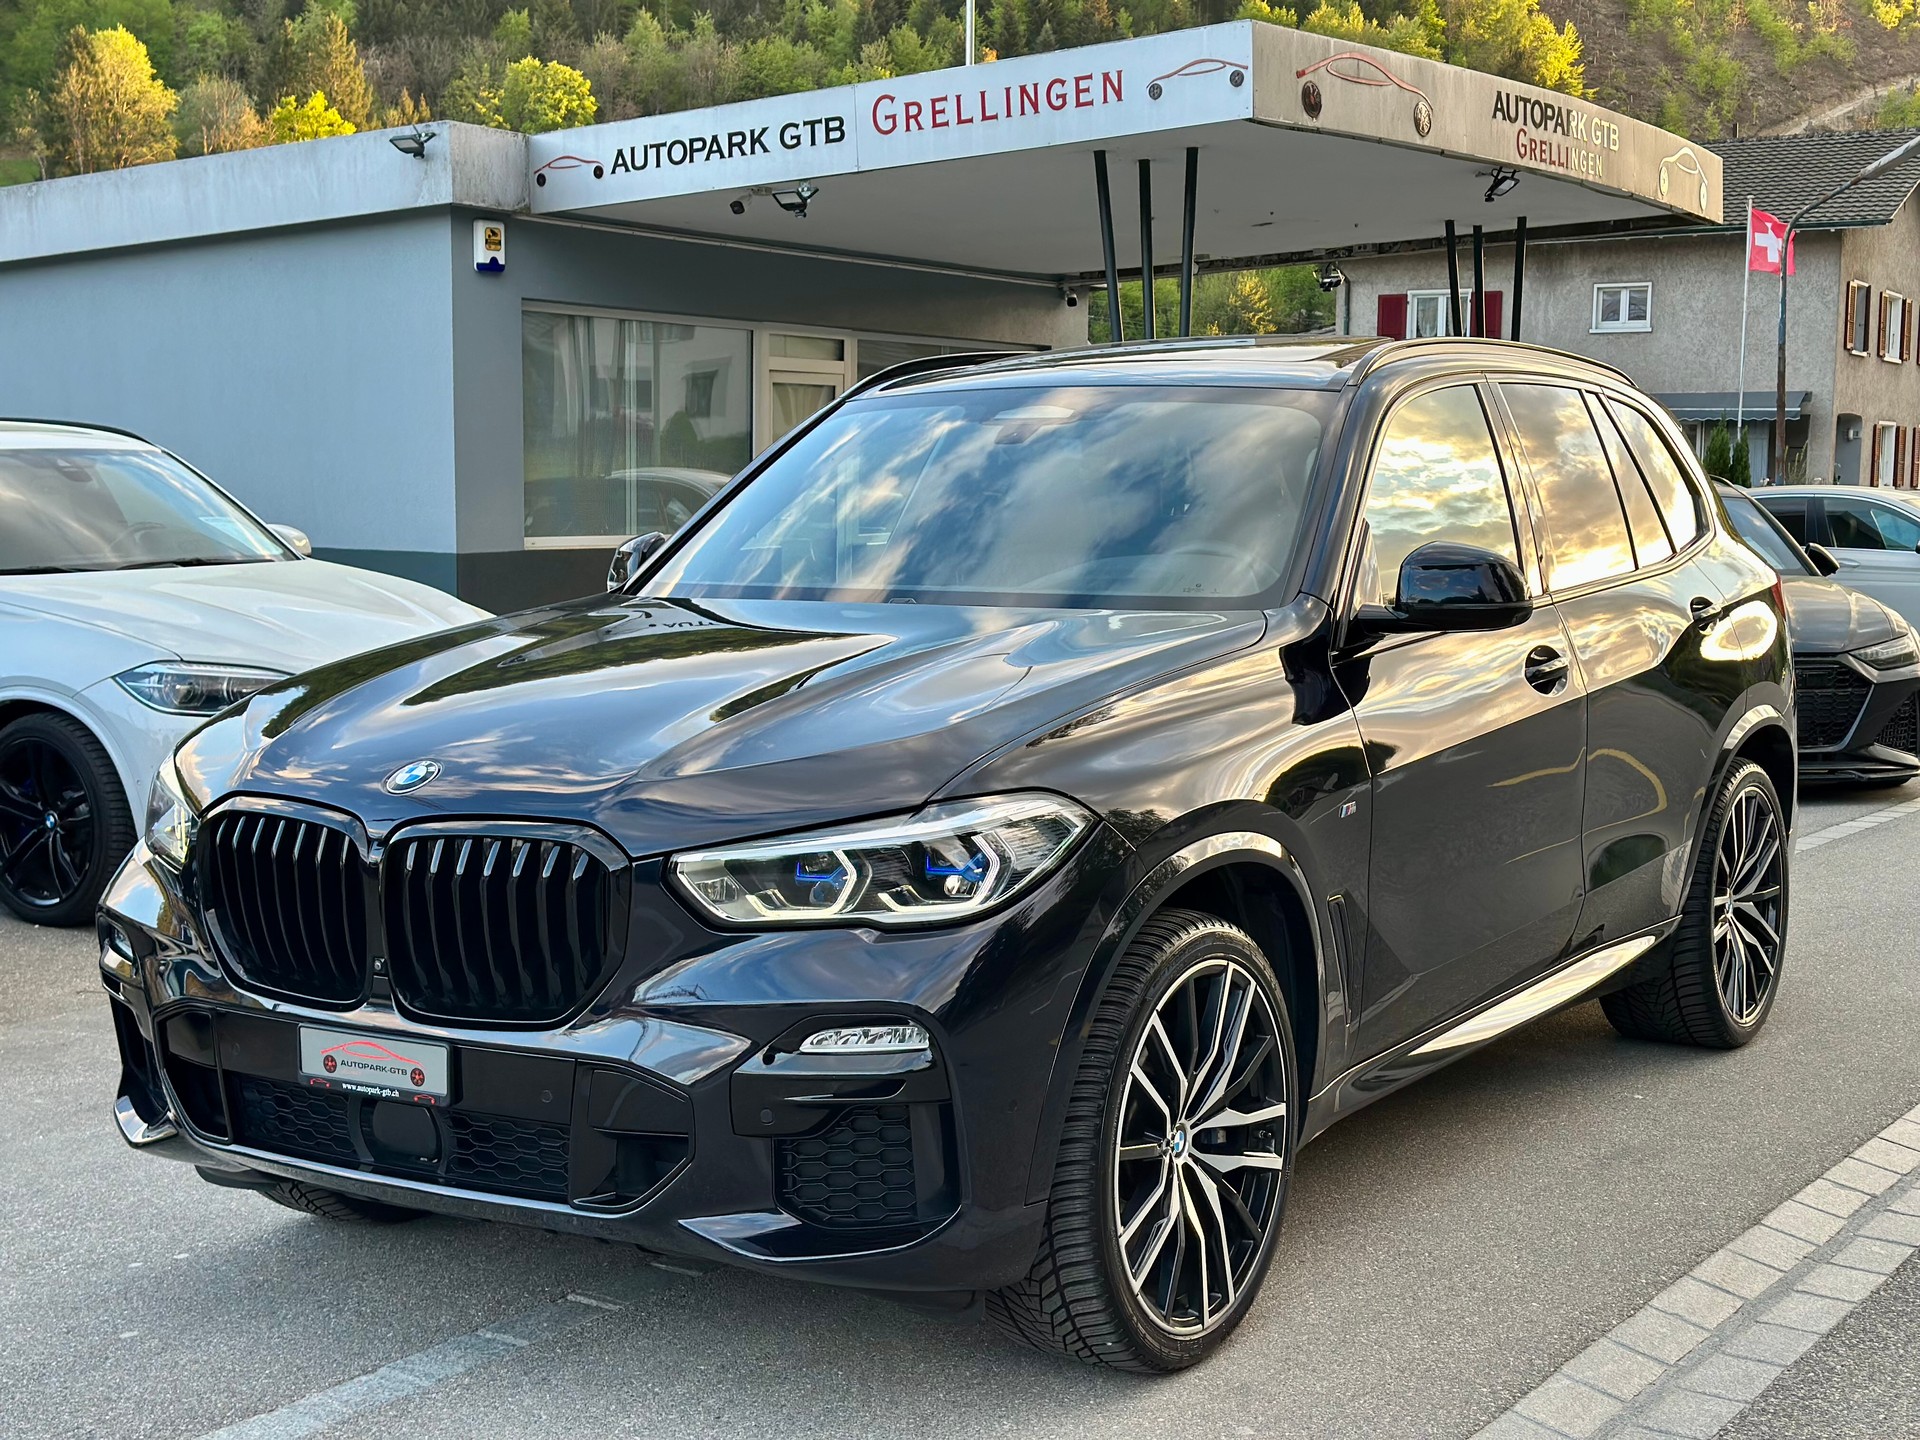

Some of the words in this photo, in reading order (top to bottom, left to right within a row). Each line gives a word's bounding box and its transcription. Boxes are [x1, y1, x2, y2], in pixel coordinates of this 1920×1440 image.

[872, 69, 1124, 136] GRELLINGEN
[1492, 90, 1588, 142] AUTOPARK
[1591, 116, 1620, 152] GTB
[610, 126, 771, 175] AUTOPARK
[779, 115, 846, 150] GTB
[1516, 128, 1603, 178] GRELLINGEN
[340, 1059, 408, 1076] AUTOPARK-GTB
[341, 1082, 400, 1098] www.autopark-gtb.ch
